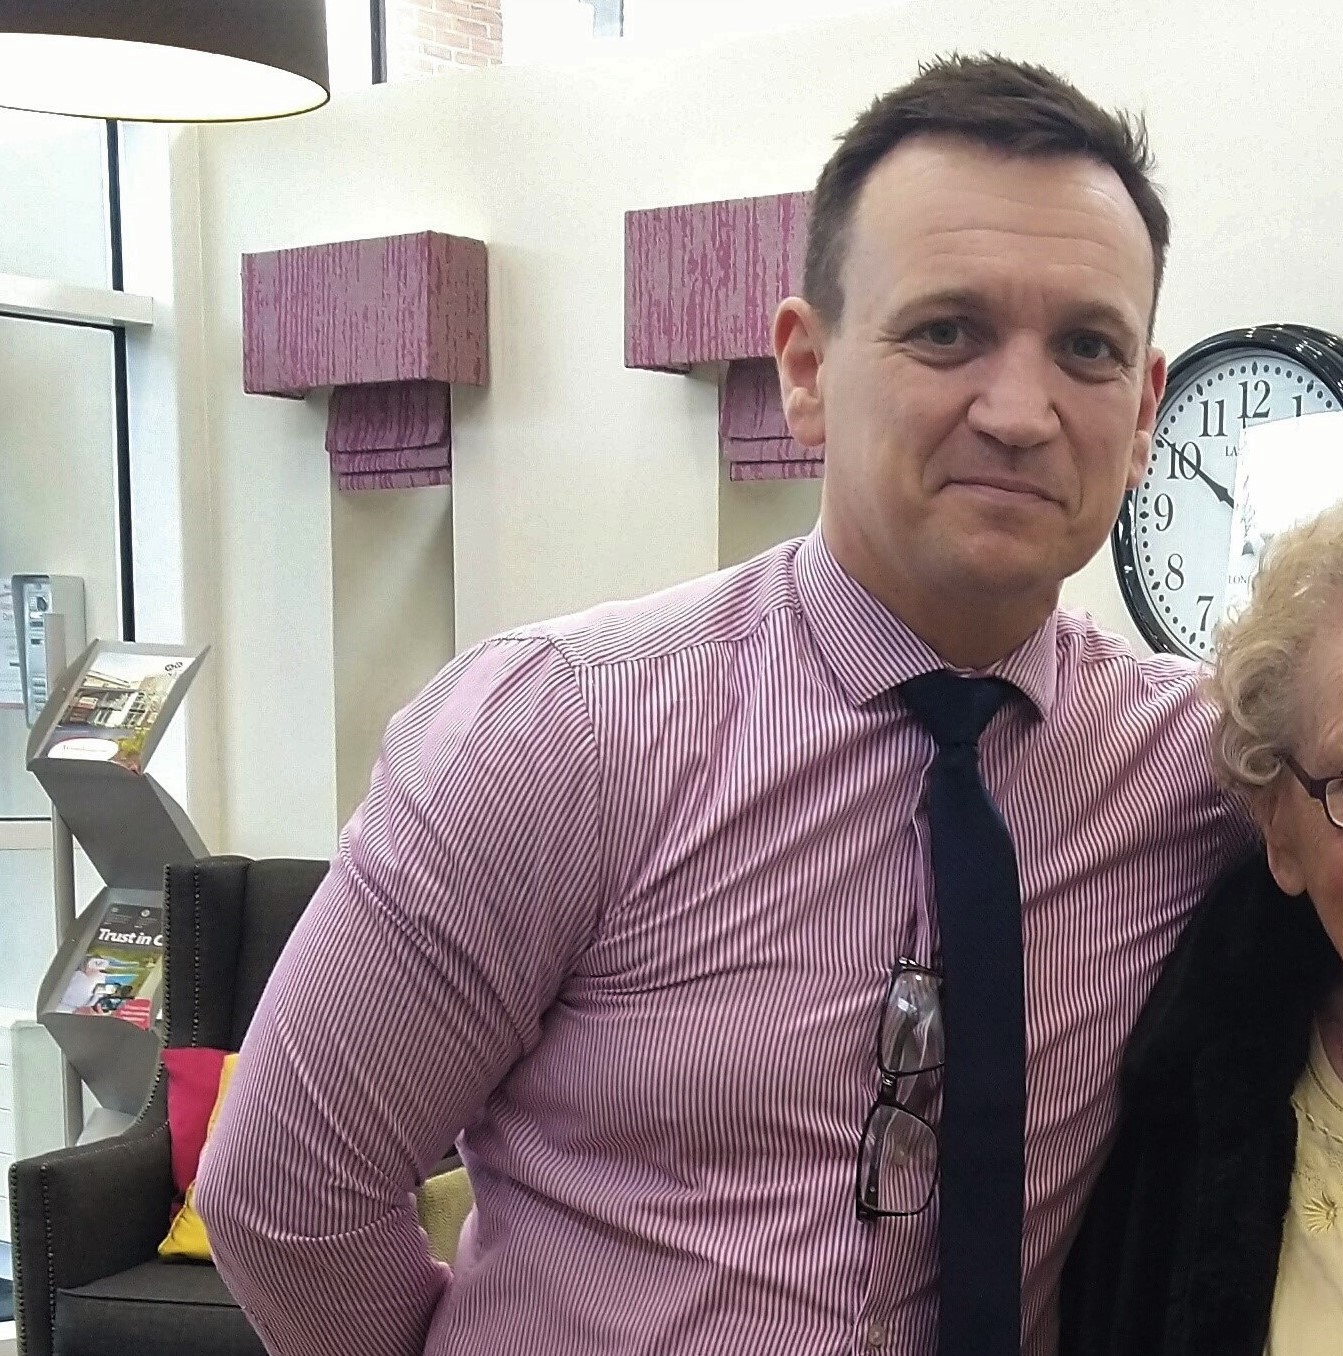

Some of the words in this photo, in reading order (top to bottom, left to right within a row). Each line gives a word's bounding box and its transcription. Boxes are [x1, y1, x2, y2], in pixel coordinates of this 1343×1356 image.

[1199, 399, 1228, 437] 11
[1237, 380, 1271, 419] 12
[1166, 441, 1201, 480] 10
[1154, 493, 1174, 531] 9
[1165, 553, 1184, 591] 8
[1196, 595, 1214, 631] 7
[98, 928, 137, 944] Trust
[136, 932, 152, 945] in
